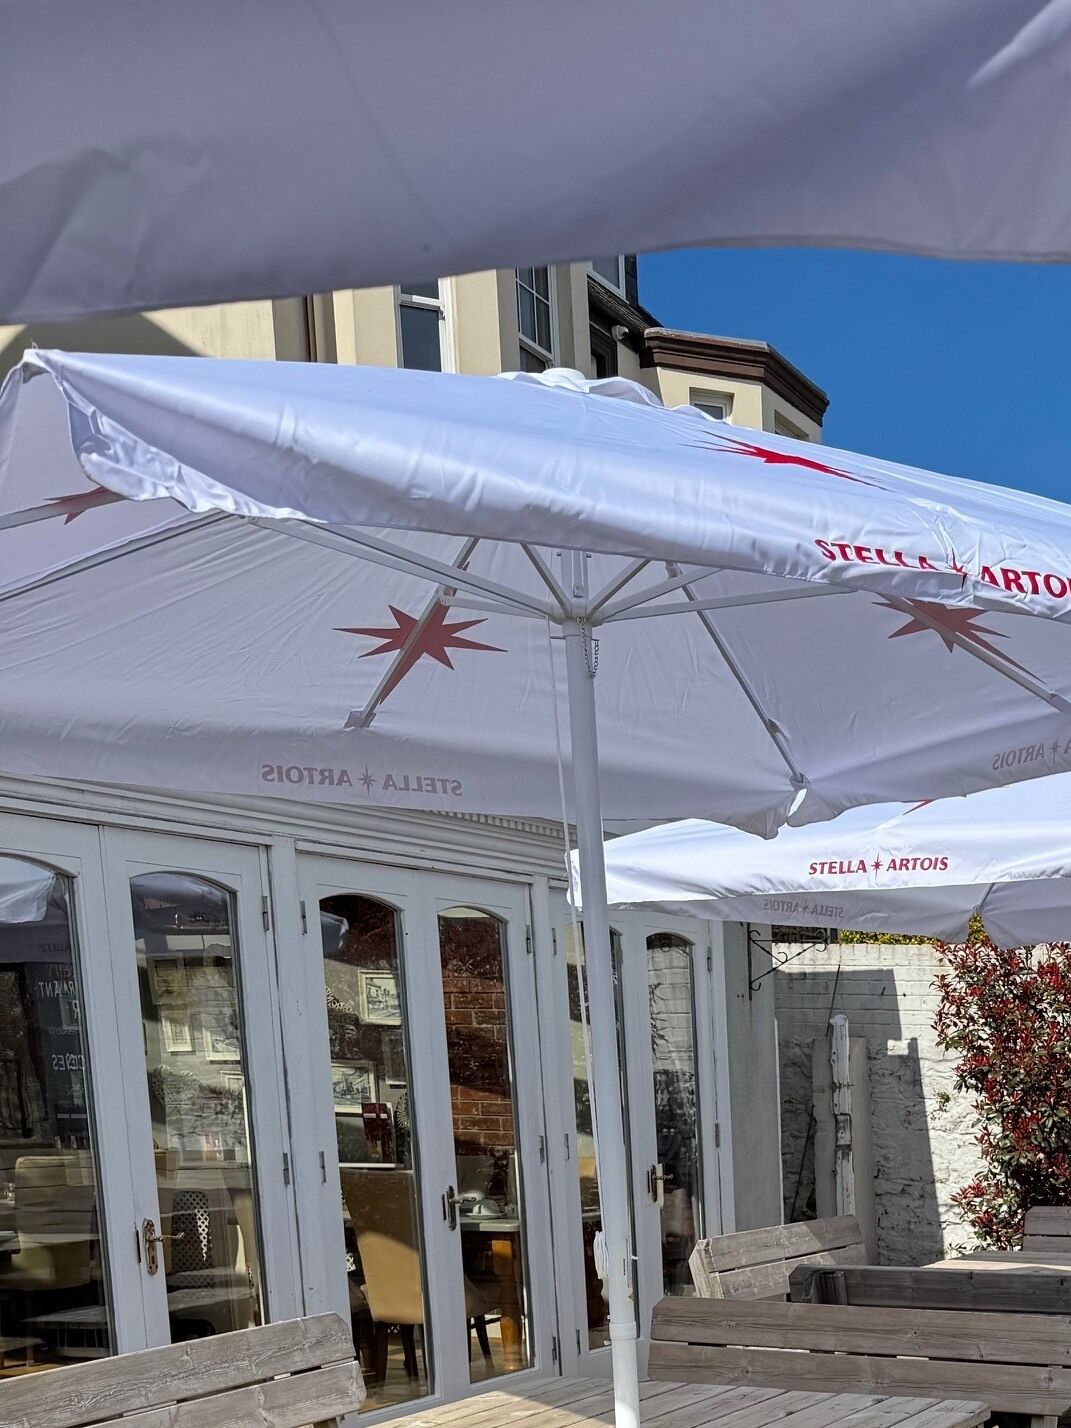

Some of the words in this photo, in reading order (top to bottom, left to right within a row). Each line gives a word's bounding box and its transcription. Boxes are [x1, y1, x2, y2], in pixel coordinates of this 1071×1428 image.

[815, 539, 938, 571] STELLA
[808, 859, 868, 875] STELLA
[886, 856, 949, 872] ARTOIS
